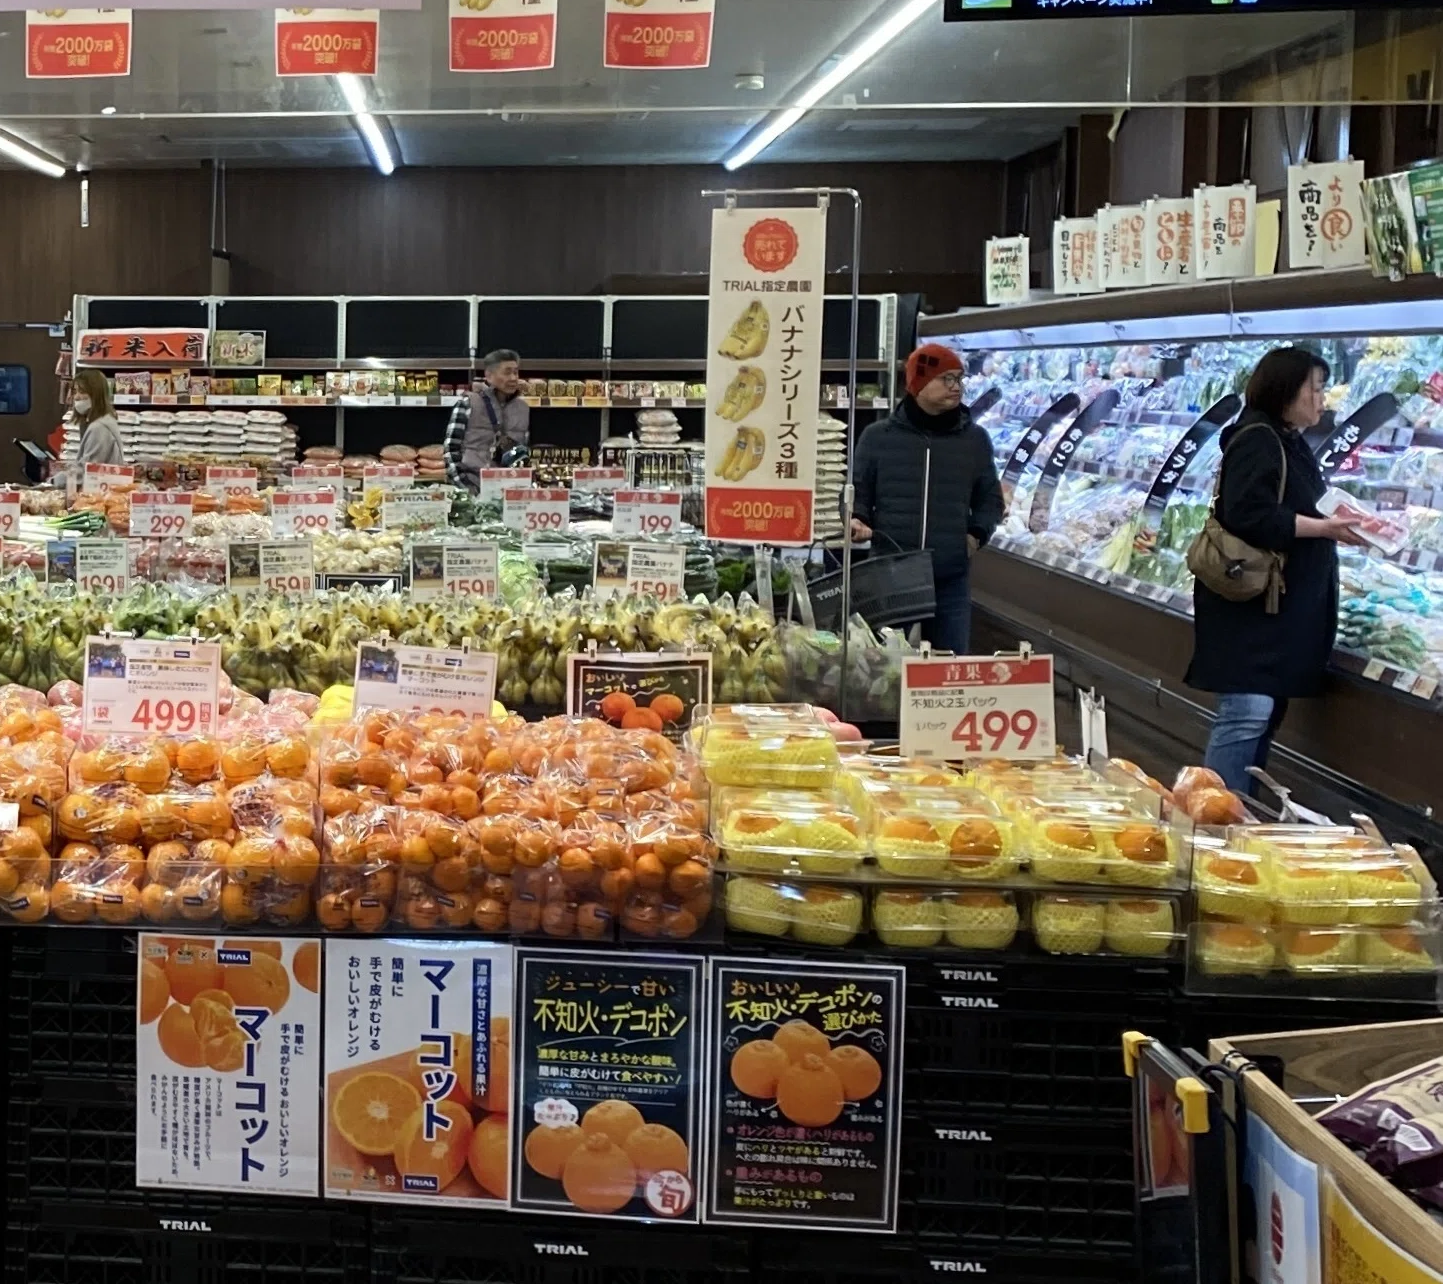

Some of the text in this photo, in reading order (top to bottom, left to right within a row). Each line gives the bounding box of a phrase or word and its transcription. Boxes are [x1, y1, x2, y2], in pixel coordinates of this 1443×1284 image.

[82, 334, 203, 358] 新米入荷
[775, 305, 804, 480] バナナシリーズ3種
[150, 515, 185, 533] 299
[525, 512, 562, 528] 399
[639, 515, 672, 532] 199
[946, 664, 981, 680] 青果
[911, 697, 997, 708] 不知火2玉パック
[132, 699, 196, 732] 499
[952, 710, 1038, 751] 499
[219, 952, 249, 963] TRIAL
[391, 957, 404, 997] 簡単に
[940, 969, 999, 982] TRIAL
[546, 975, 675, 997] ジューシーで甘い
[347, 956, 362, 1058] おいしいオレンジ
[368, 957, 382, 1051] 手で皮がむける
[941, 996, 999, 1008] TRIAL
[533, 998, 688, 1037] 不知火・デコポン
[294, 1024, 304, 1056] 簡単に
[418, 958, 456, 1141] マーコット
[234, 1006, 271, 1182] マーコット
[935, 1129, 992, 1141] TRIAL
[406, 1178, 436, 1188] TRIAL
[659, 1183, 682, 1212] 旬
[160, 1219, 212, 1232] TRIAL
[533, 1244, 589, 1257] TRIAL
[930, 1261, 987, 1273] TRIAL
